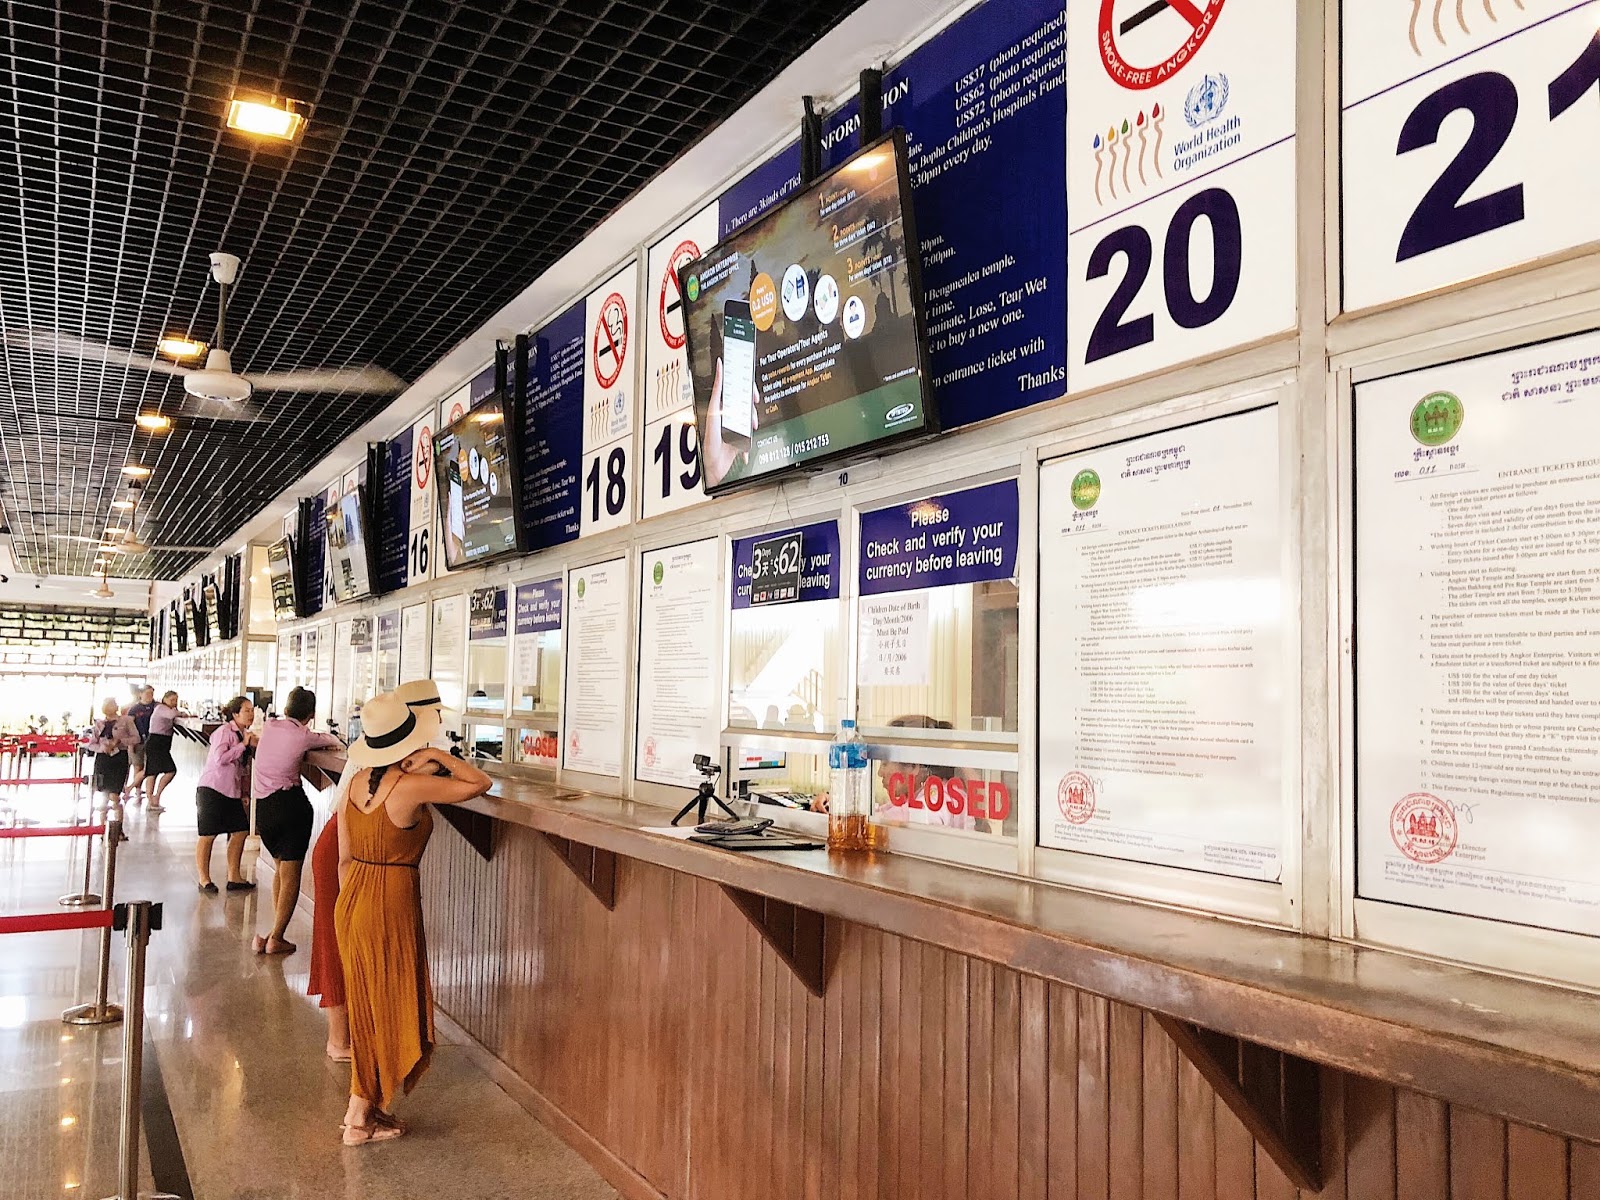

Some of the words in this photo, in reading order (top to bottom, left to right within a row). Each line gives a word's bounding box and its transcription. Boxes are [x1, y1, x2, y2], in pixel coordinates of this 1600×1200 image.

[956, 64, 985, 93] US$37
[989, 44, 1019, 73] (photo
[1022, 9, 1067, 50] required)
[1102, 30, 1152, 85] SMOKE-FREE
[1156, 11, 1213, 79] ANGKOR
[956, 82, 985, 111] US$62
[989, 62, 1019, 91] (photo
[1022, 29, 1067, 69] required)
[956, 100, 985, 128] US$72
[990, 80, 1020, 108] (photo
[920, 145, 945, 169] Bopha
[947, 118, 991, 151] Children's
[993, 89, 1037, 124] Hospitals
[1174, 133, 1203, 156] World
[1207, 115, 1241, 141] Health
[943, 146, 970, 171] every
[972, 134, 993, 155] day.
[1174, 133, 1241, 171] Organization
[929, 270, 980, 301] Bengmealea
[982, 254, 1016, 277] temple.
[1084, 188, 1242, 365] 20
[932, 300, 955, 318] time.
[969, 301, 996, 321] Lose,
[1025, 276, 1047, 297] Wet
[937, 339, 946, 351] to
[948, 328, 967, 347] buy
[969, 328, 975, 339] a
[978, 318, 999, 335] new
[1002, 307, 1025, 325] one.
[943, 360, 985, 384] entrance
[987, 348, 1017, 370] ticket
[1020, 335, 1044, 357] with
[1017, 365, 1065, 391] Thanks
[654, 423, 700, 499] 19
[838, 472, 848, 487] 10
[1498, 467, 1539, 478] ENTRANCE
[1541, 462, 1575, 473] TICKETS
[586, 446, 626, 523] 18
[911, 505, 949, 528] Please
[410, 528, 429, 577] 16
[866, 537, 900, 559] Check
[905, 532, 926, 555] and
[932, 523, 966, 548] verify
[972, 520, 1003, 545] your
[738, 564, 752, 578] Che
[810, 553, 831, 571] your
[752, 548, 762, 580] 3
[761, 561, 769, 577] 天
[866, 558, 912, 581] currency
[915, 549, 954, 574] before
[956, 545, 1003, 570] leaving
[518, 603, 529, 614] Check
[530, 601, 538, 611] and
[550, 599, 560, 611] your
[533, 588, 545, 599] Please
[1510, 652, 1531, 660] Angkor
[524, 735, 557, 758] CLOSE
[888, 772, 1011, 822] CLOSED
